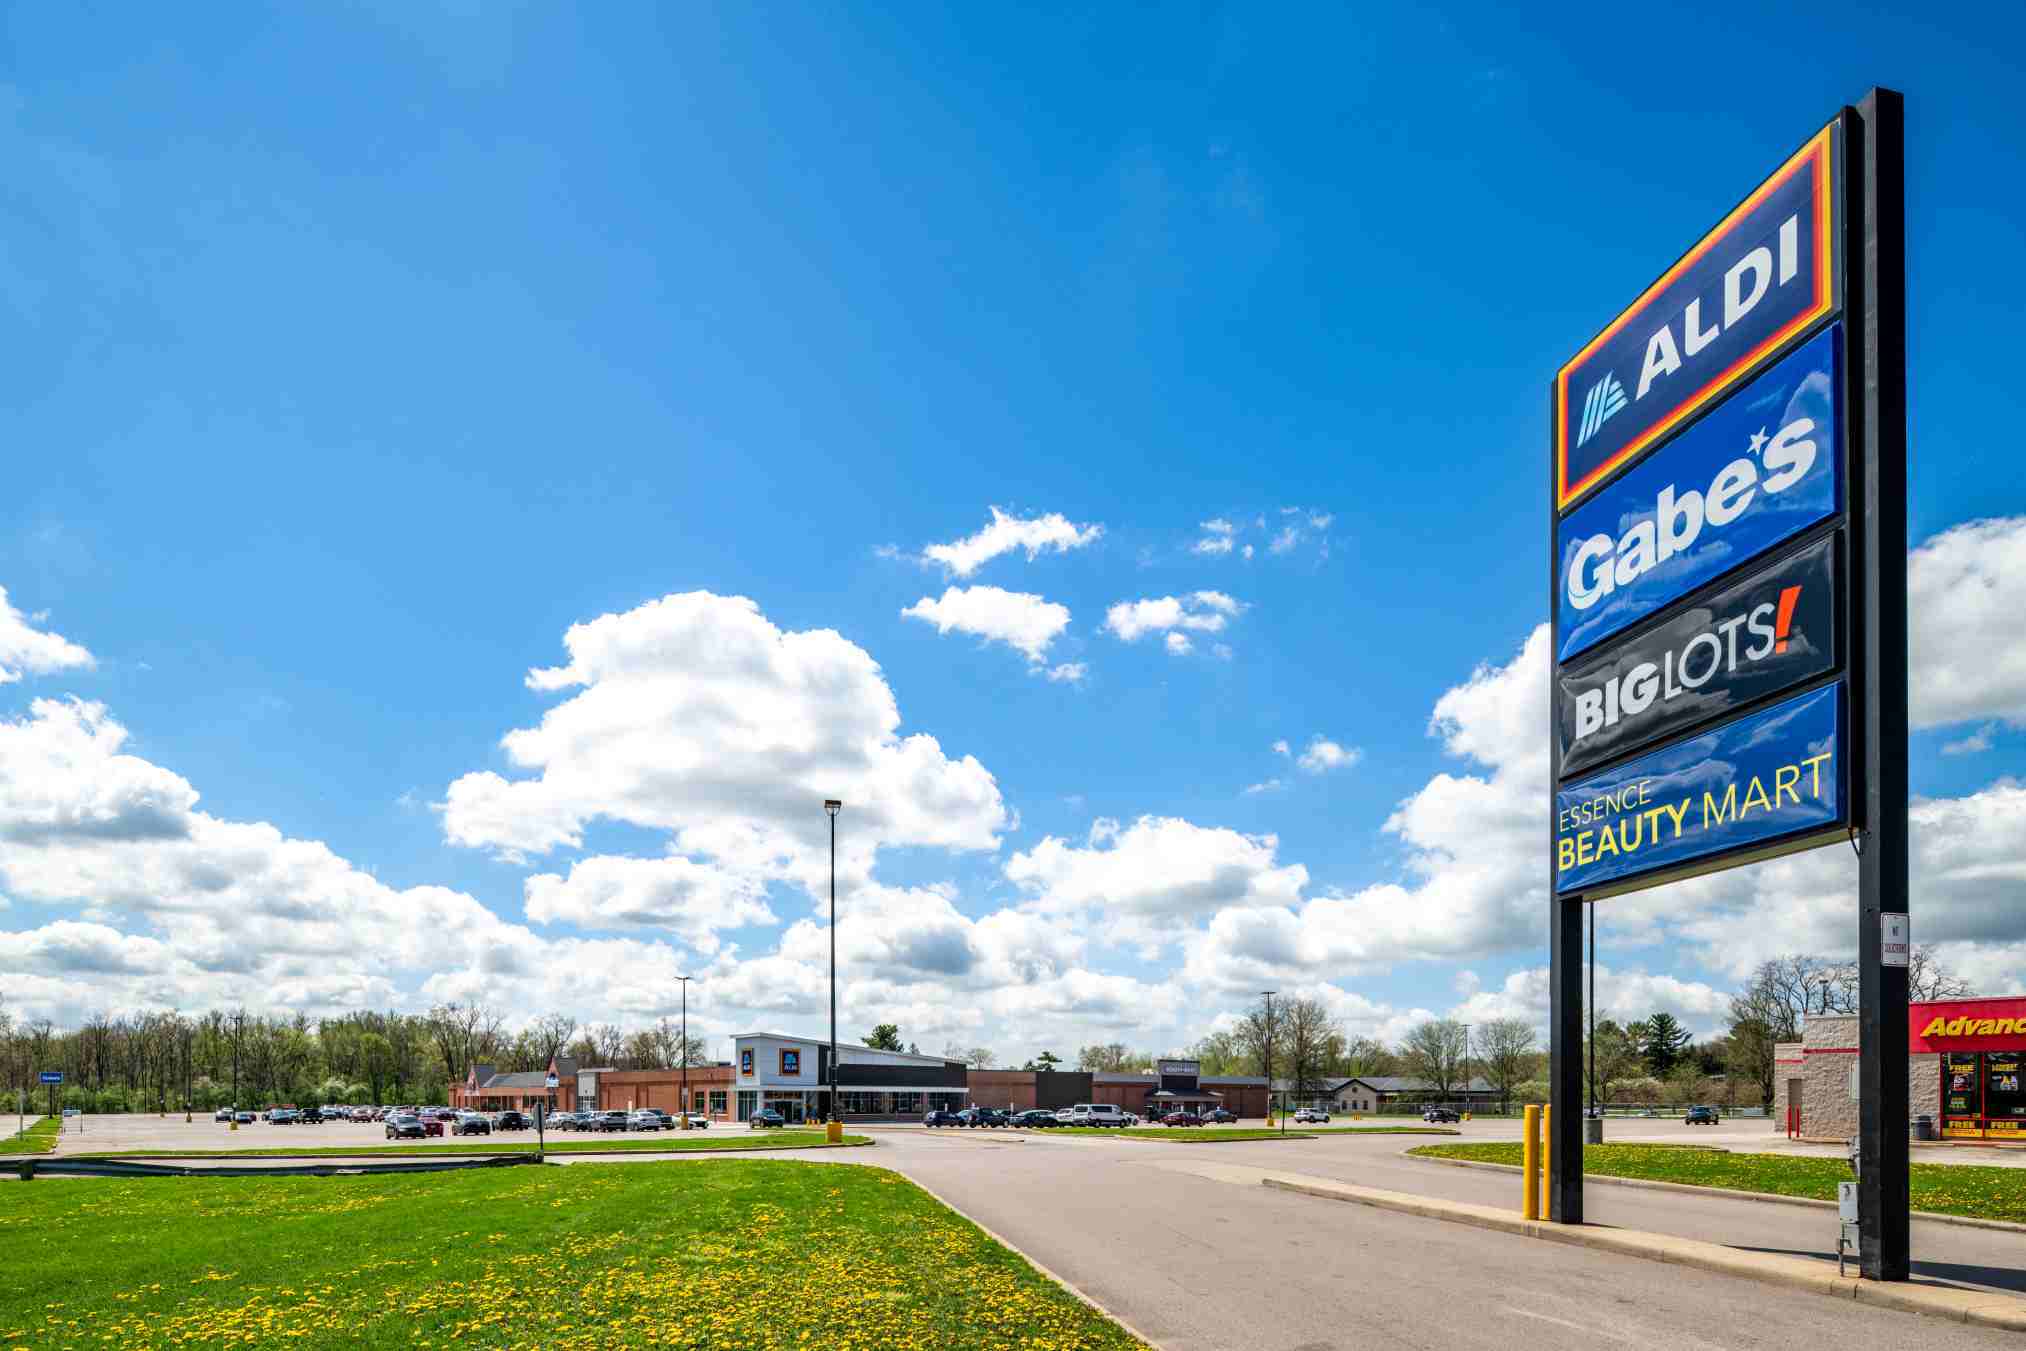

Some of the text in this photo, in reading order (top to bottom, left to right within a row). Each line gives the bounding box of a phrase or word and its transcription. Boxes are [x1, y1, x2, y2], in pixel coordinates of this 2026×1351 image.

[1636, 214, 1798, 401] ALDI
[1567, 417, 1817, 610] Gabe's
[1558, 752, 1832, 872] BEAUTY MART
[1559, 780, 1652, 833] ESSENCE
